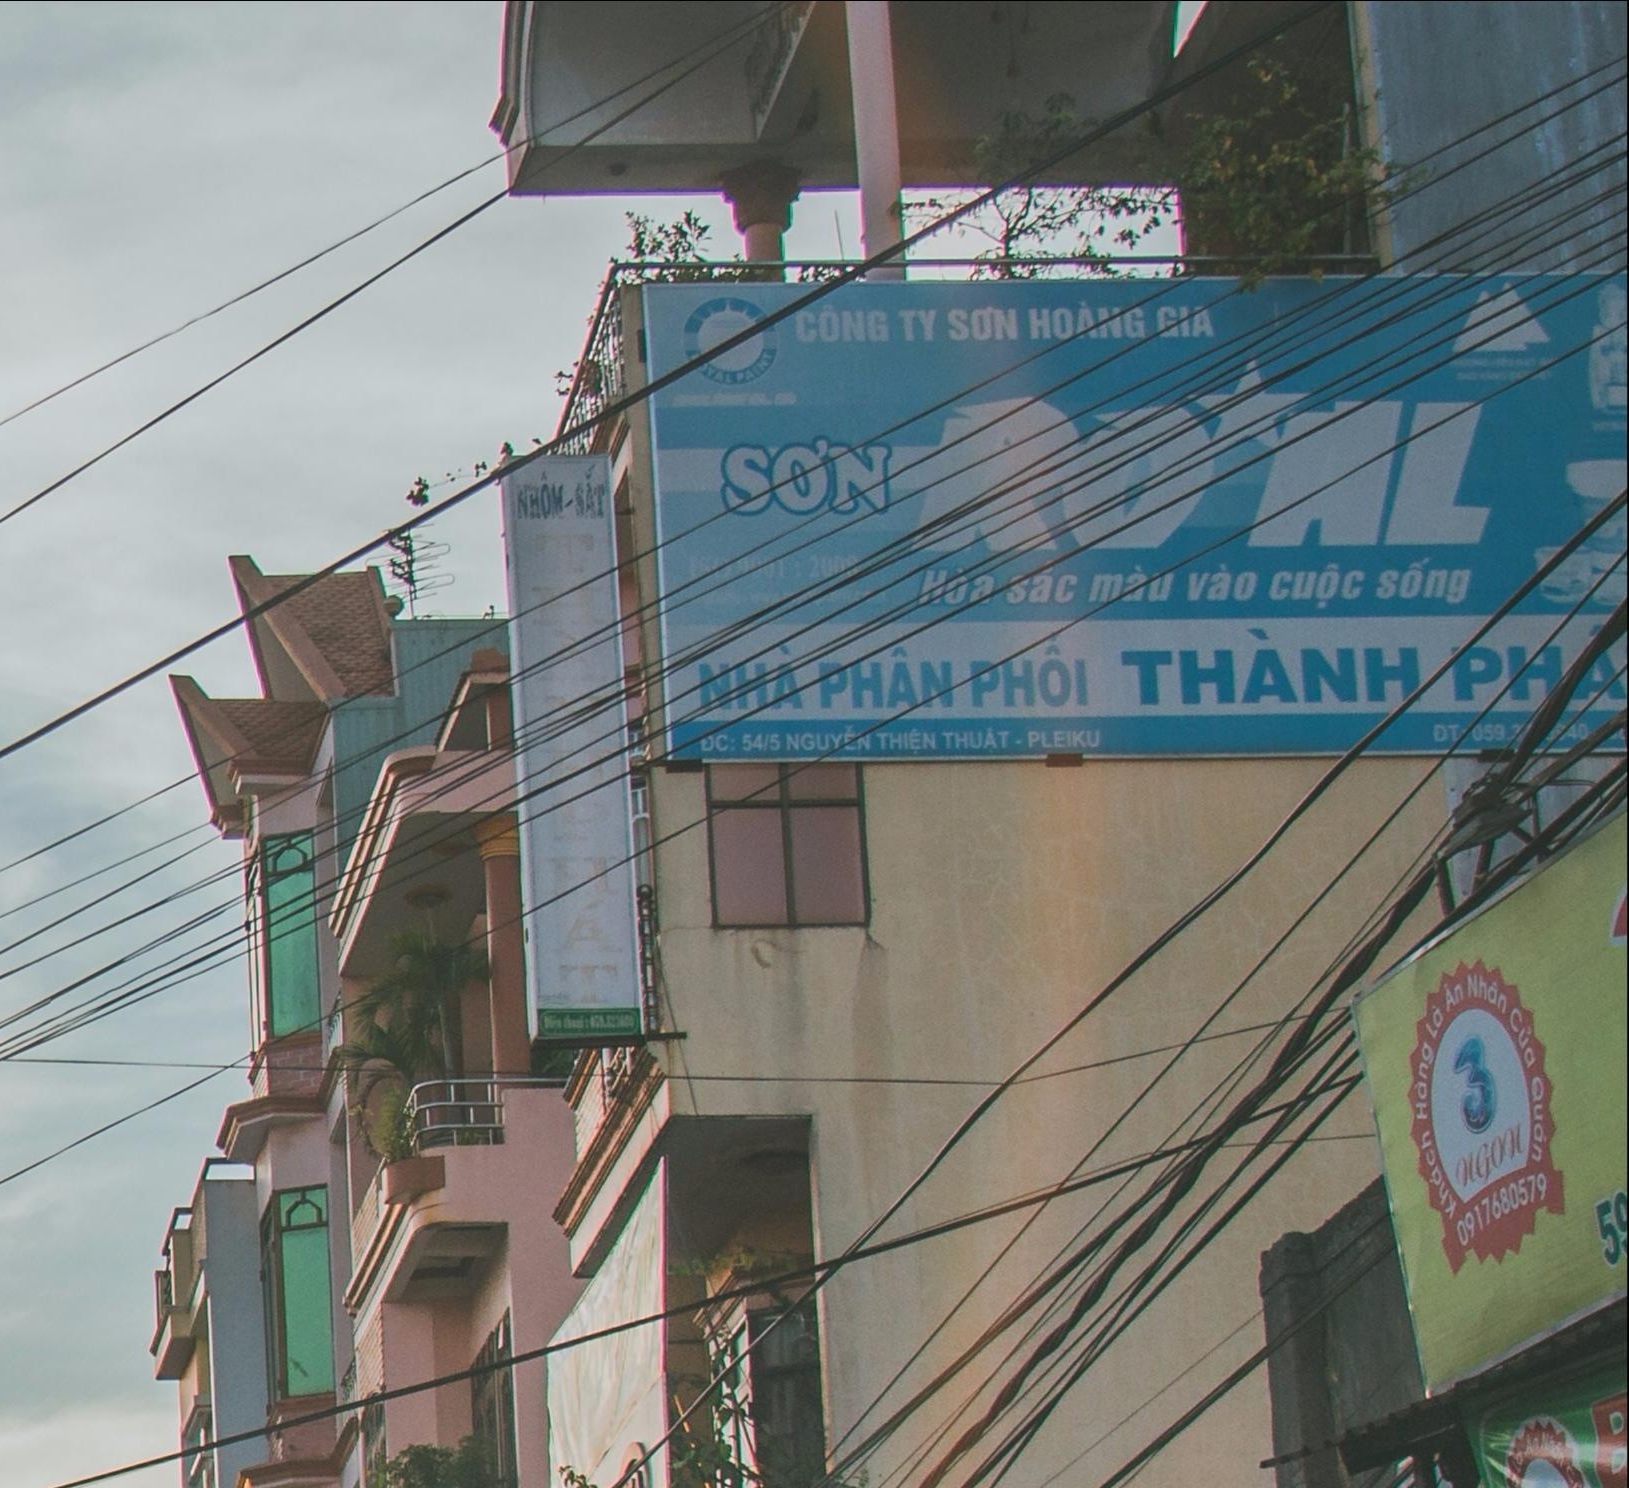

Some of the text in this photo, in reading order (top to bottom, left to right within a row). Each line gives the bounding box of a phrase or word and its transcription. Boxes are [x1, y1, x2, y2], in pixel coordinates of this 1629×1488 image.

[795, 304, 1215, 342] CÔNG TY SƠN HOÀNG GIA
[719, 434, 893, 517] SƠN
[916, 556, 1473, 608] Hòa sắc màu vào cuộc sống
[697, 643, 804, 711] NHÀ
[818, 647, 955, 709] PHÂN
[970, 636, 1089, 708] PHỐI
[1120, 628, 1424, 706] THÀNH
[700, 730, 737, 751] ĐC:
[742, 731, 781, 752] 54/5
[786, 725, 872, 752] NGUYỄN
[876, 728, 937, 755] THIỆN
[1028, 731, 1101, 748] PLEIKU
[1416, 973, 1548, 1221] Khách Hàng Là Ân Nhân Của Quán
[1456, 1172, 1547, 1247] 0917680579
